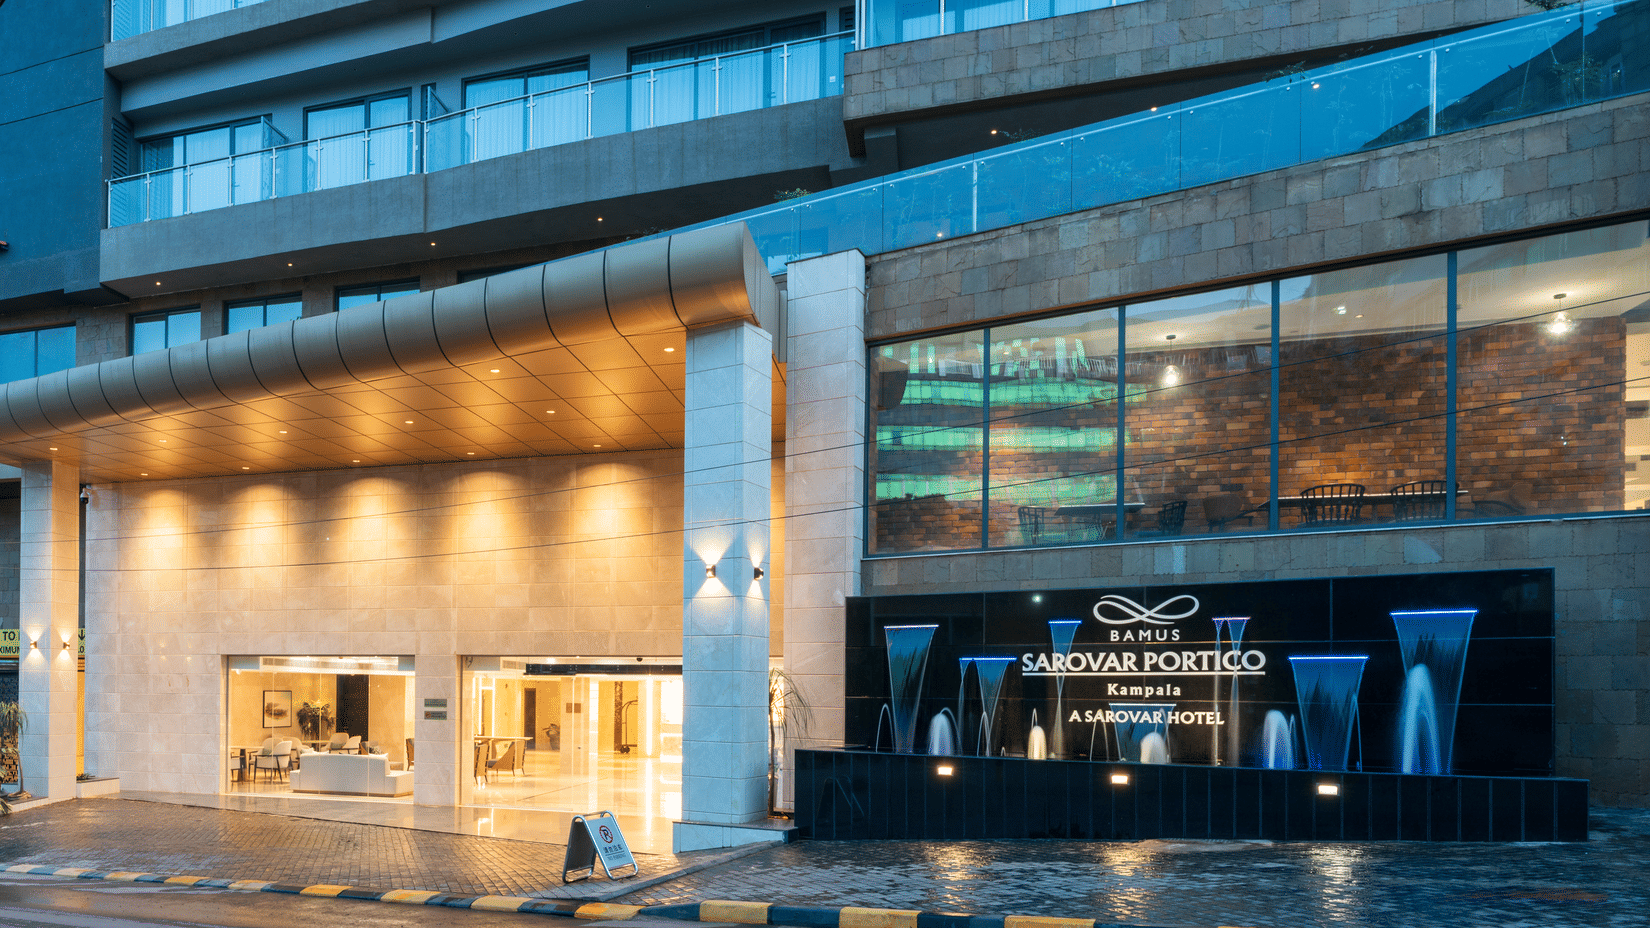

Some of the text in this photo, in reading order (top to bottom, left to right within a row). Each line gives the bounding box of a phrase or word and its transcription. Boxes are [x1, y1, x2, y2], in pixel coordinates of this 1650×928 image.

[2, 631, 16, 641] TO
[1110, 628, 1180, 642] BAMUS
[1022, 649, 1266, 672] SAROVAR PORTICO
[1107, 683, 1181, 698] Kampala
[1068, 710, 1225, 726] A SAROVAR HOTEL
